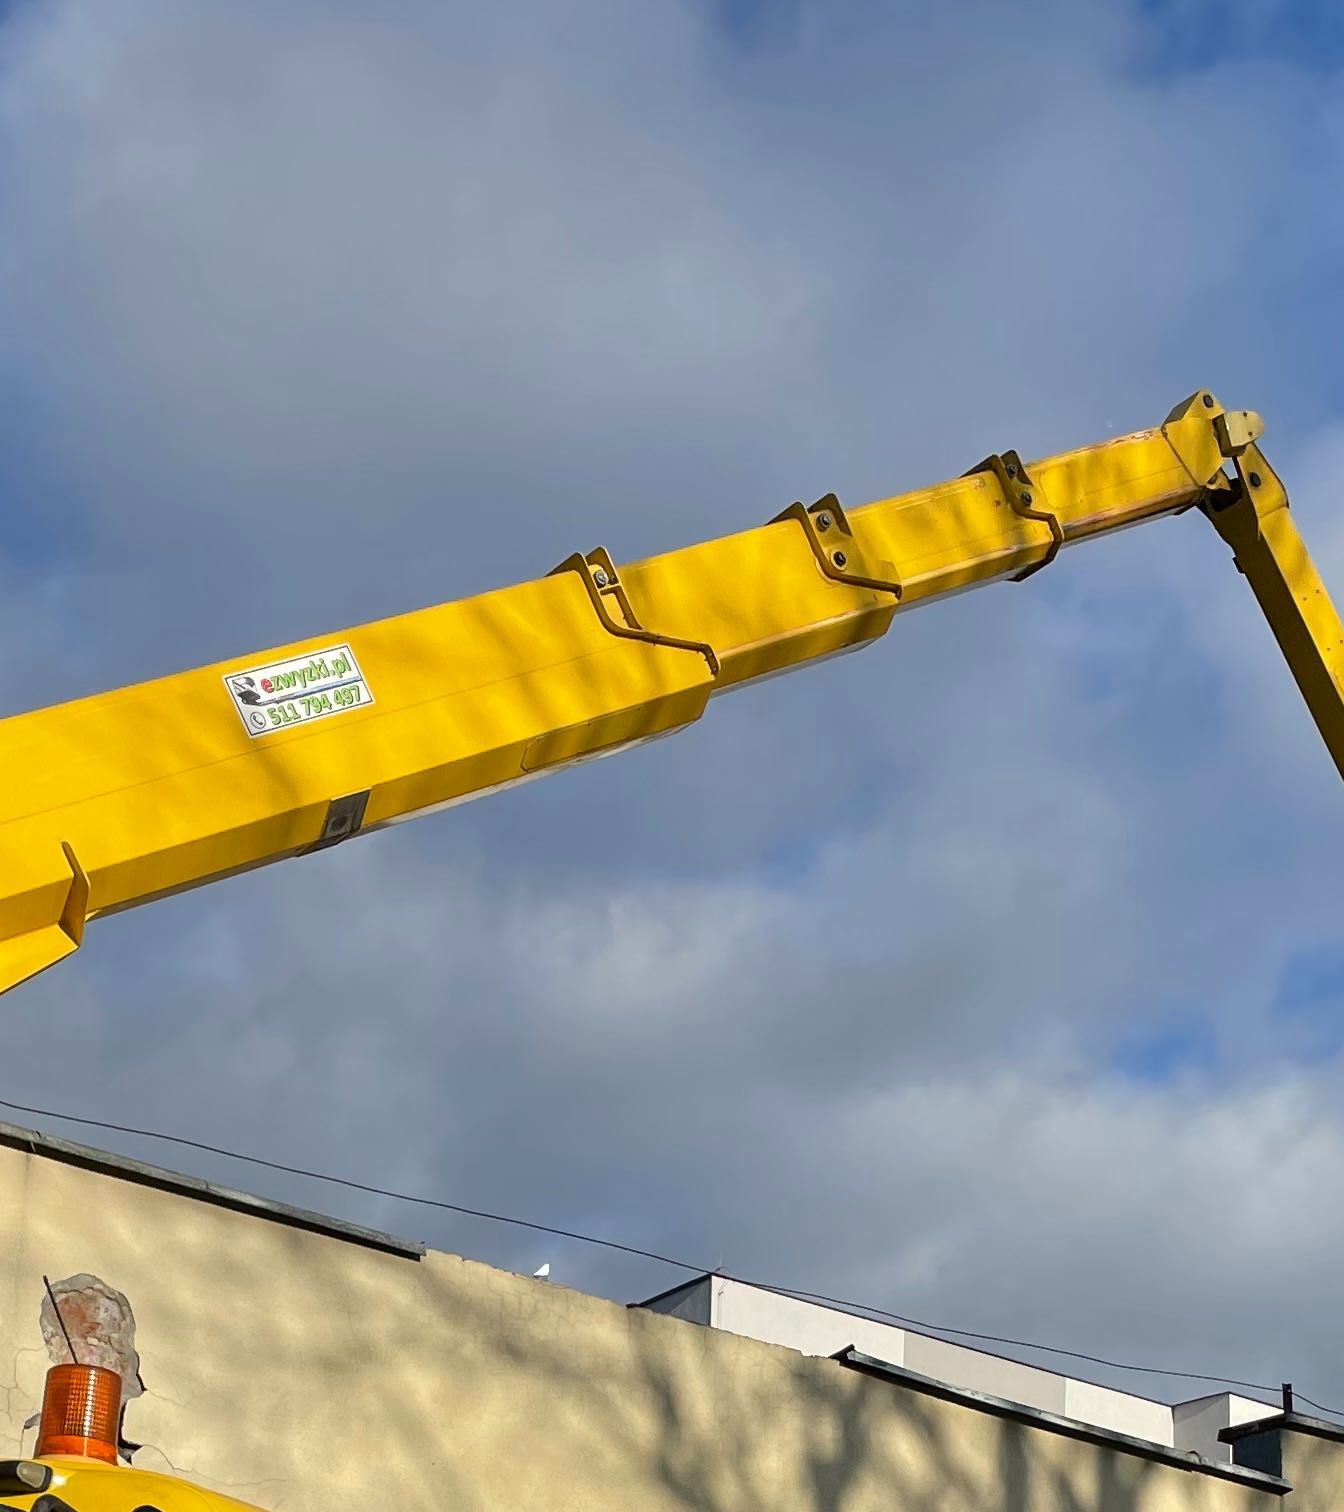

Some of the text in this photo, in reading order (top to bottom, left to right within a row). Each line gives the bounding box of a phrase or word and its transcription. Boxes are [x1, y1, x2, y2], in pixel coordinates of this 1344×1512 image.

[260, 652, 352, 693] ezwyzki.pl
[266, 684, 361, 726] 511 794 497
